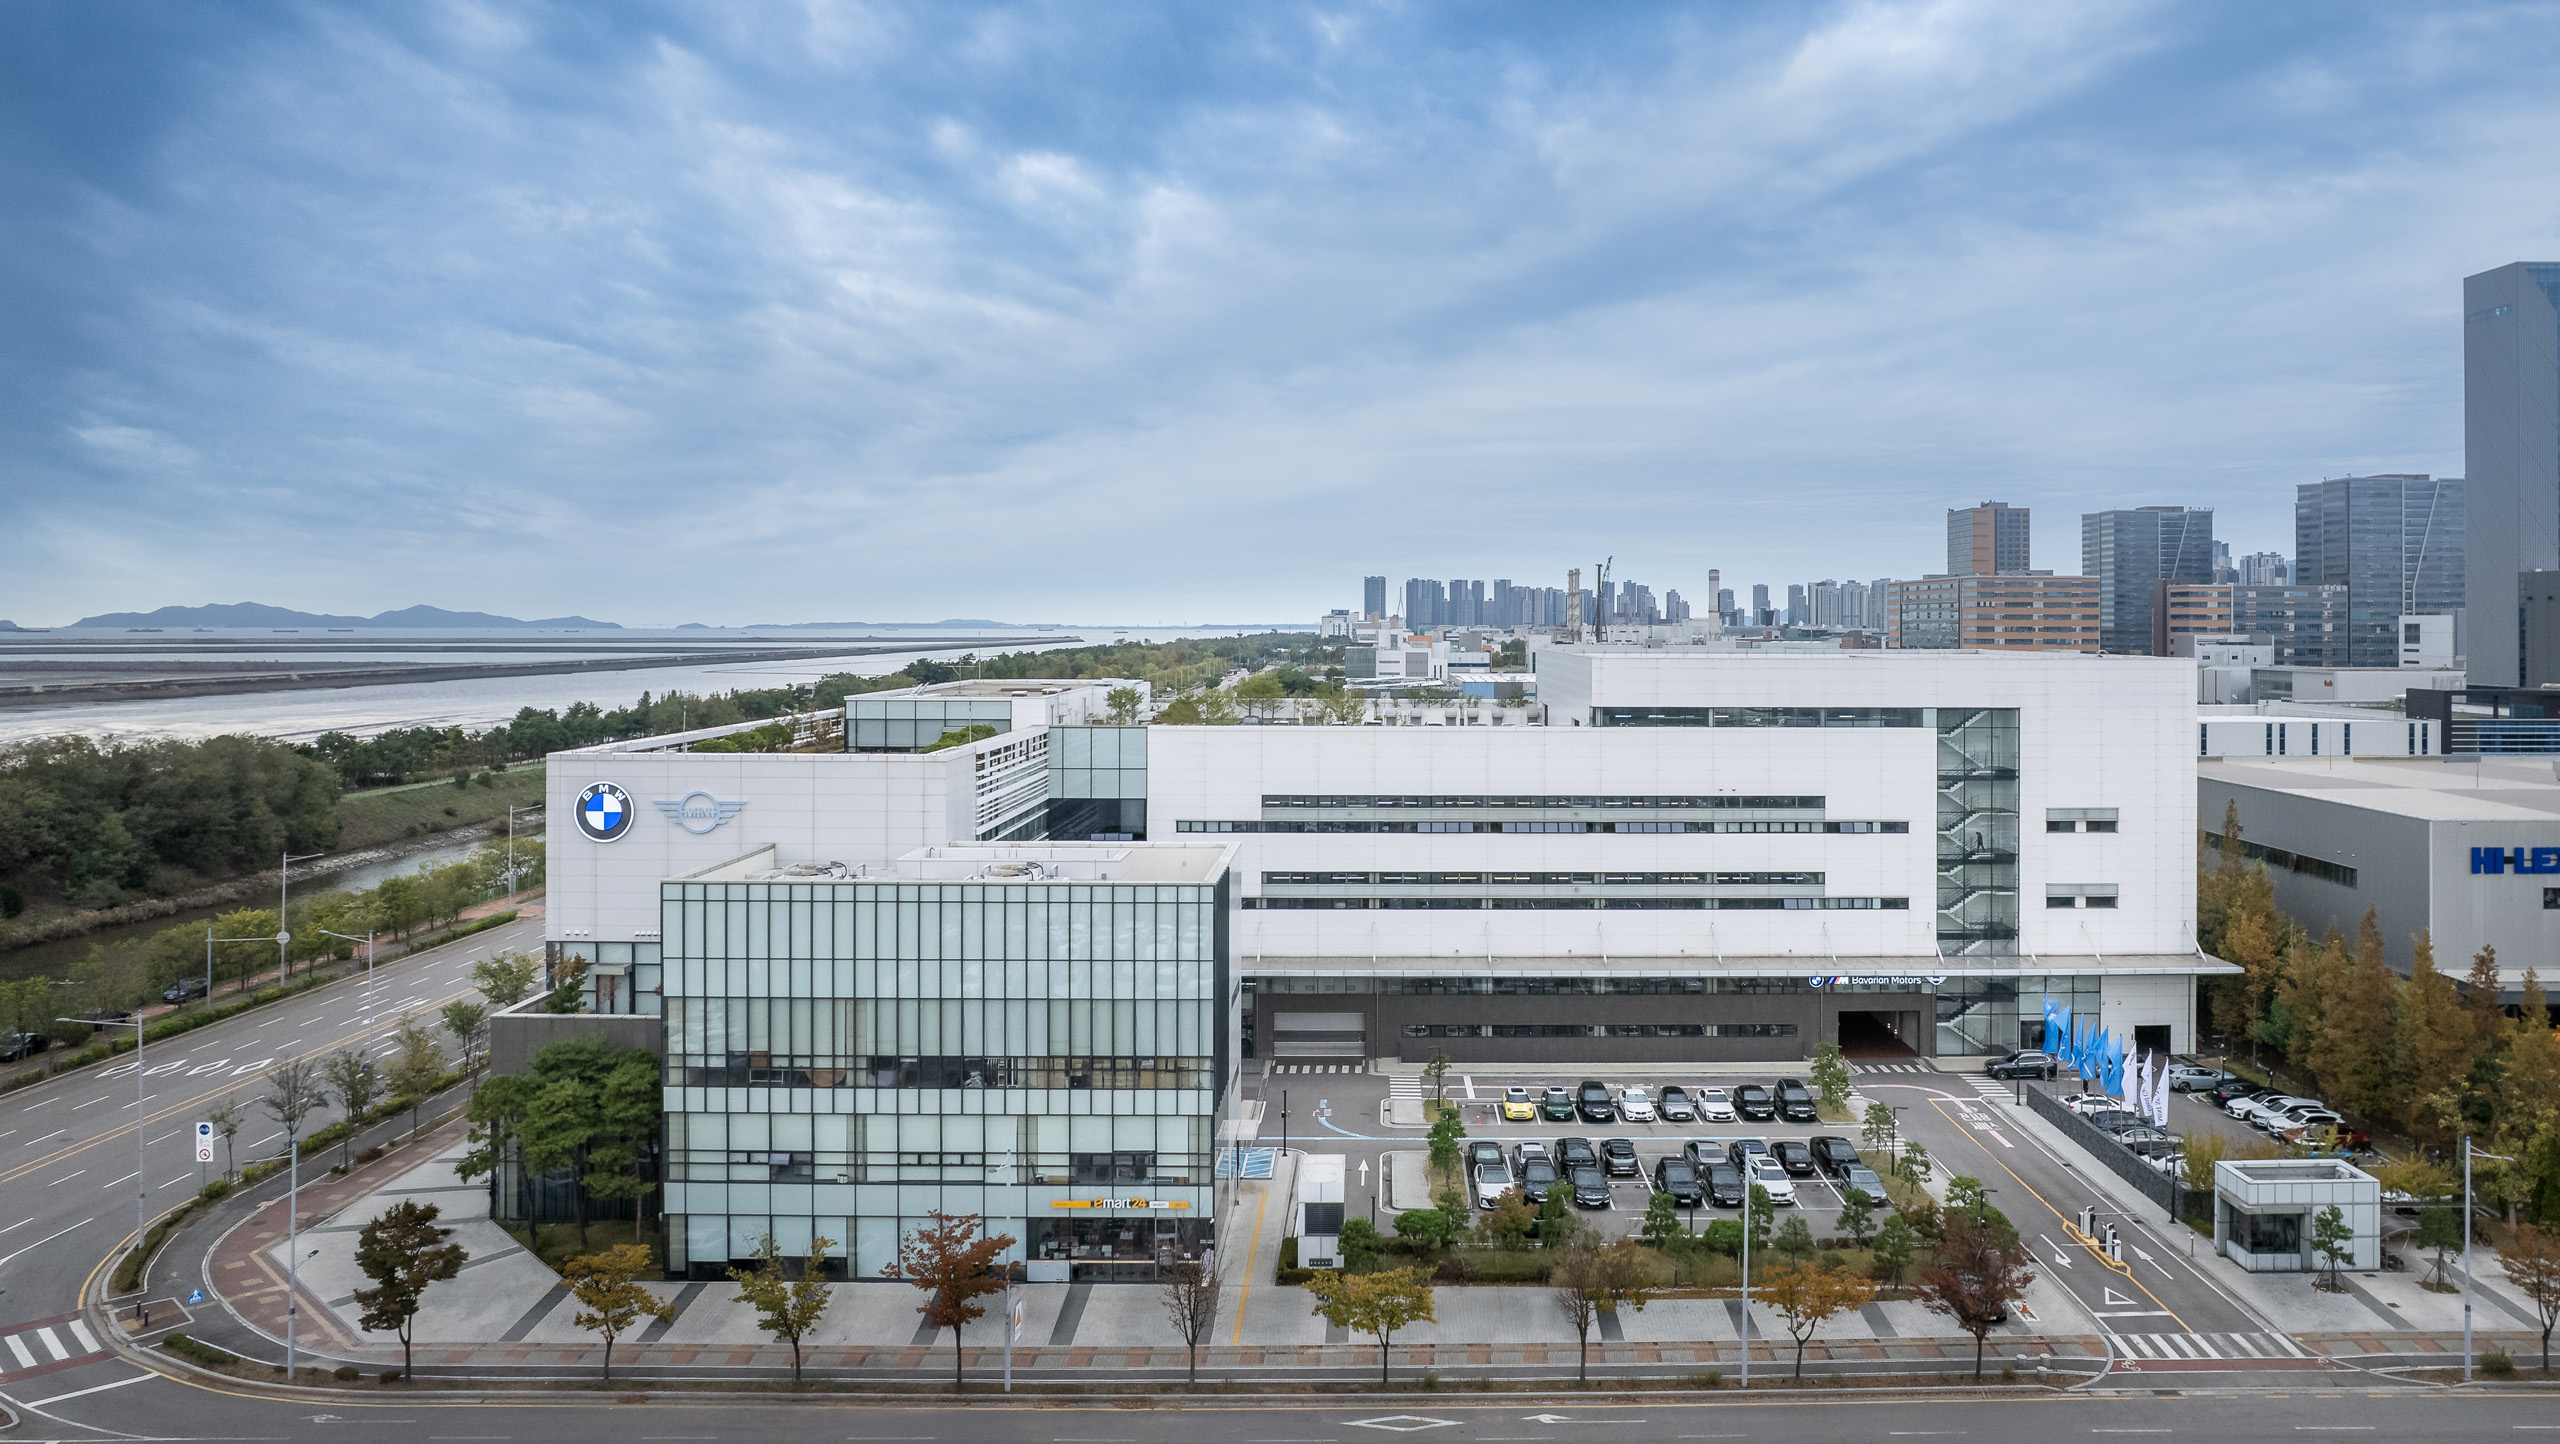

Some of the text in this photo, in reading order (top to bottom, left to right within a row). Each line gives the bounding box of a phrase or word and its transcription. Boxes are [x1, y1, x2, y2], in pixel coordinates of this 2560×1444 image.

[582, 784, 627, 802] BMW
[684, 807, 715, 818] MINI
[1851, 976, 1881, 985] Bavarian
[1891, 976, 1922, 985] Motors
[1093, 1196, 1148, 1210] emart24
